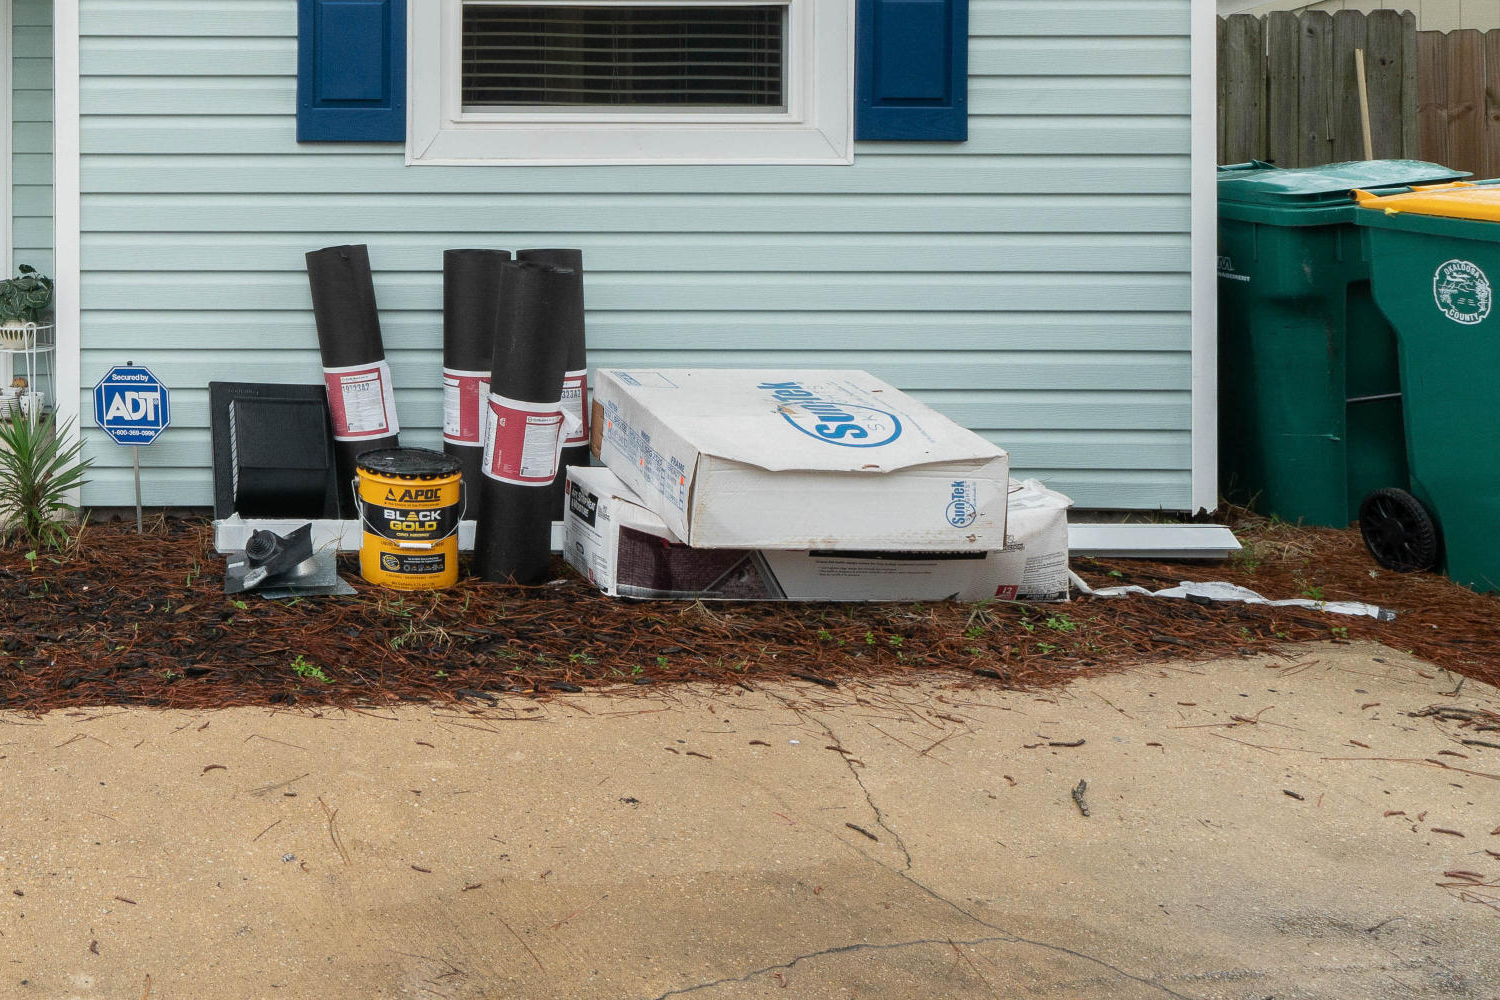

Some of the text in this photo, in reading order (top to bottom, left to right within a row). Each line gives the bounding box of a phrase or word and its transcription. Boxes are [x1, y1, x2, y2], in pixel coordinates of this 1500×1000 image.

[1443, 263, 1480, 279] OKALOOSA
[1449, 308, 1479, 321] COUNTY
[111, 373, 149, 382] Secured by
[106, 391, 159, 421] ADT
[398, 488, 442, 502] APOC
[951, 480, 965, 524] SunTek
[383, 509, 442, 521] BLACK
[389, 520, 437, 531] GOLD
